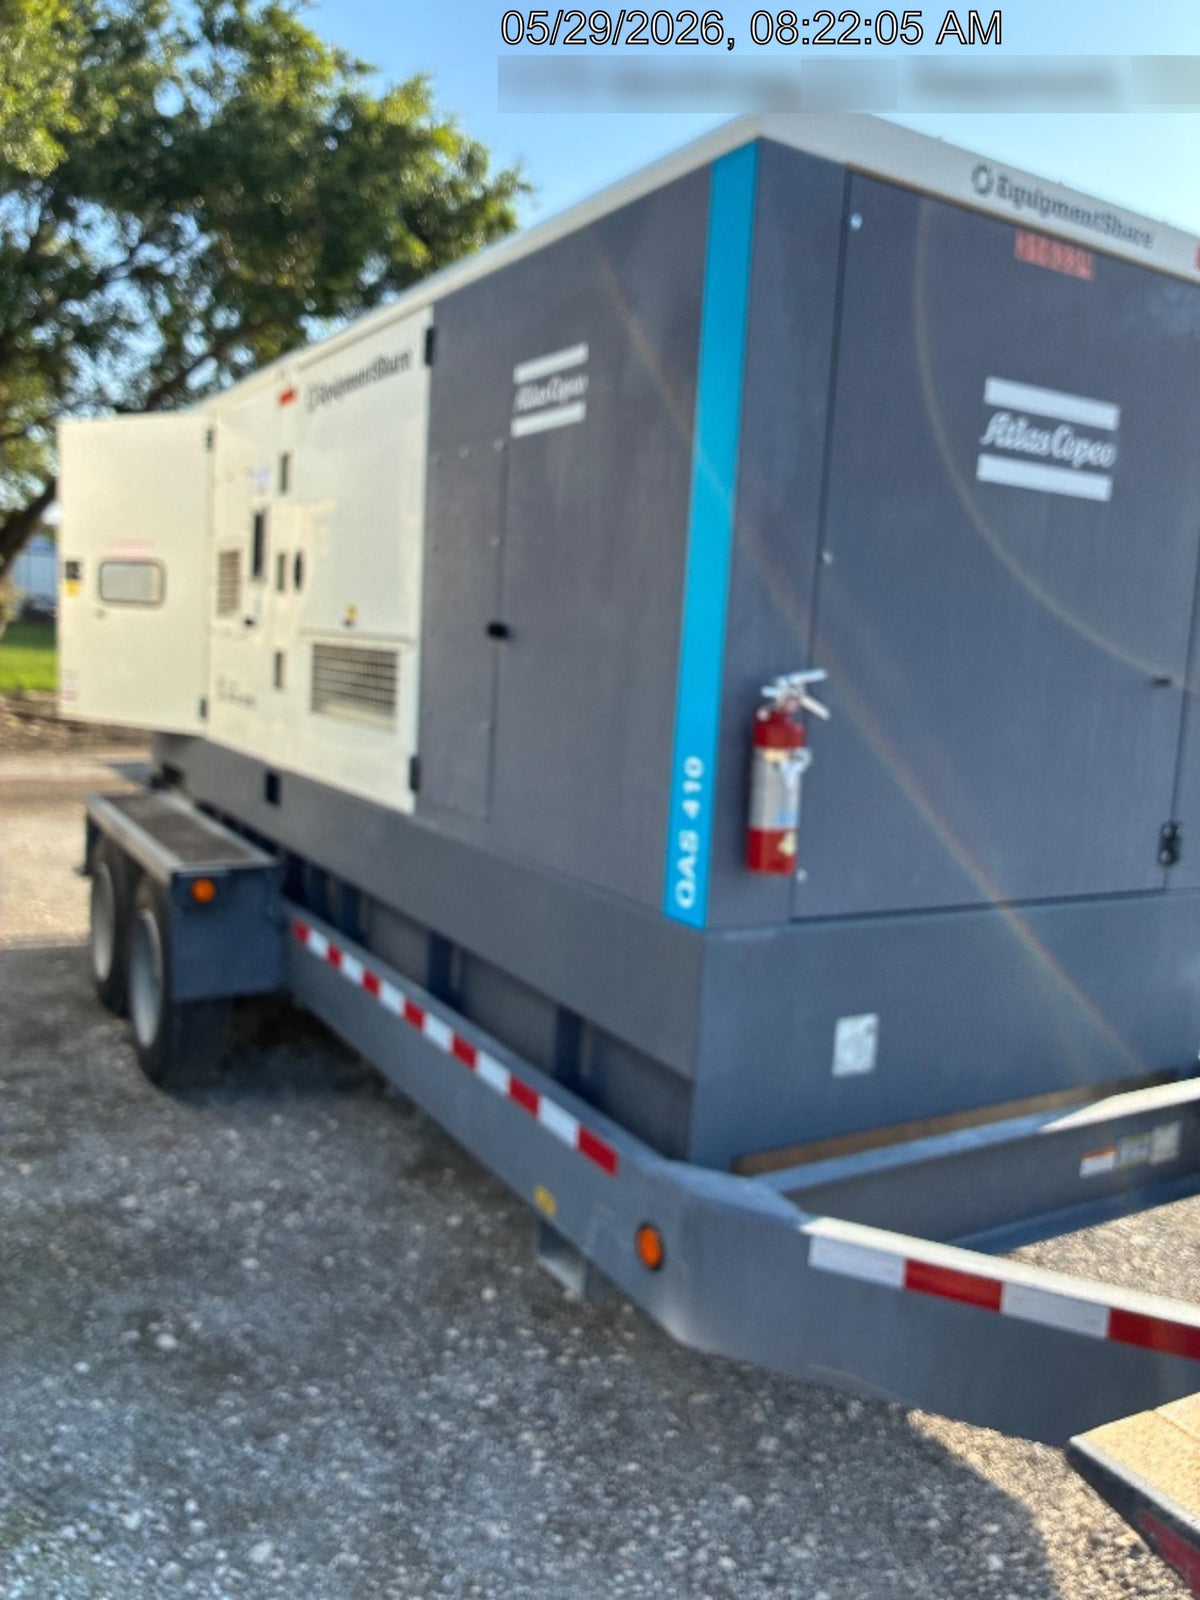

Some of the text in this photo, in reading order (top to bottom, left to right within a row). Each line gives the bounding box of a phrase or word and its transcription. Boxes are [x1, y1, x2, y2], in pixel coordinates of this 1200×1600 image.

[996, 172, 1155, 250] EquipmentShare
[979, 410, 1118, 468] Atlas Copco
[681, 754, 705, 820] 410
